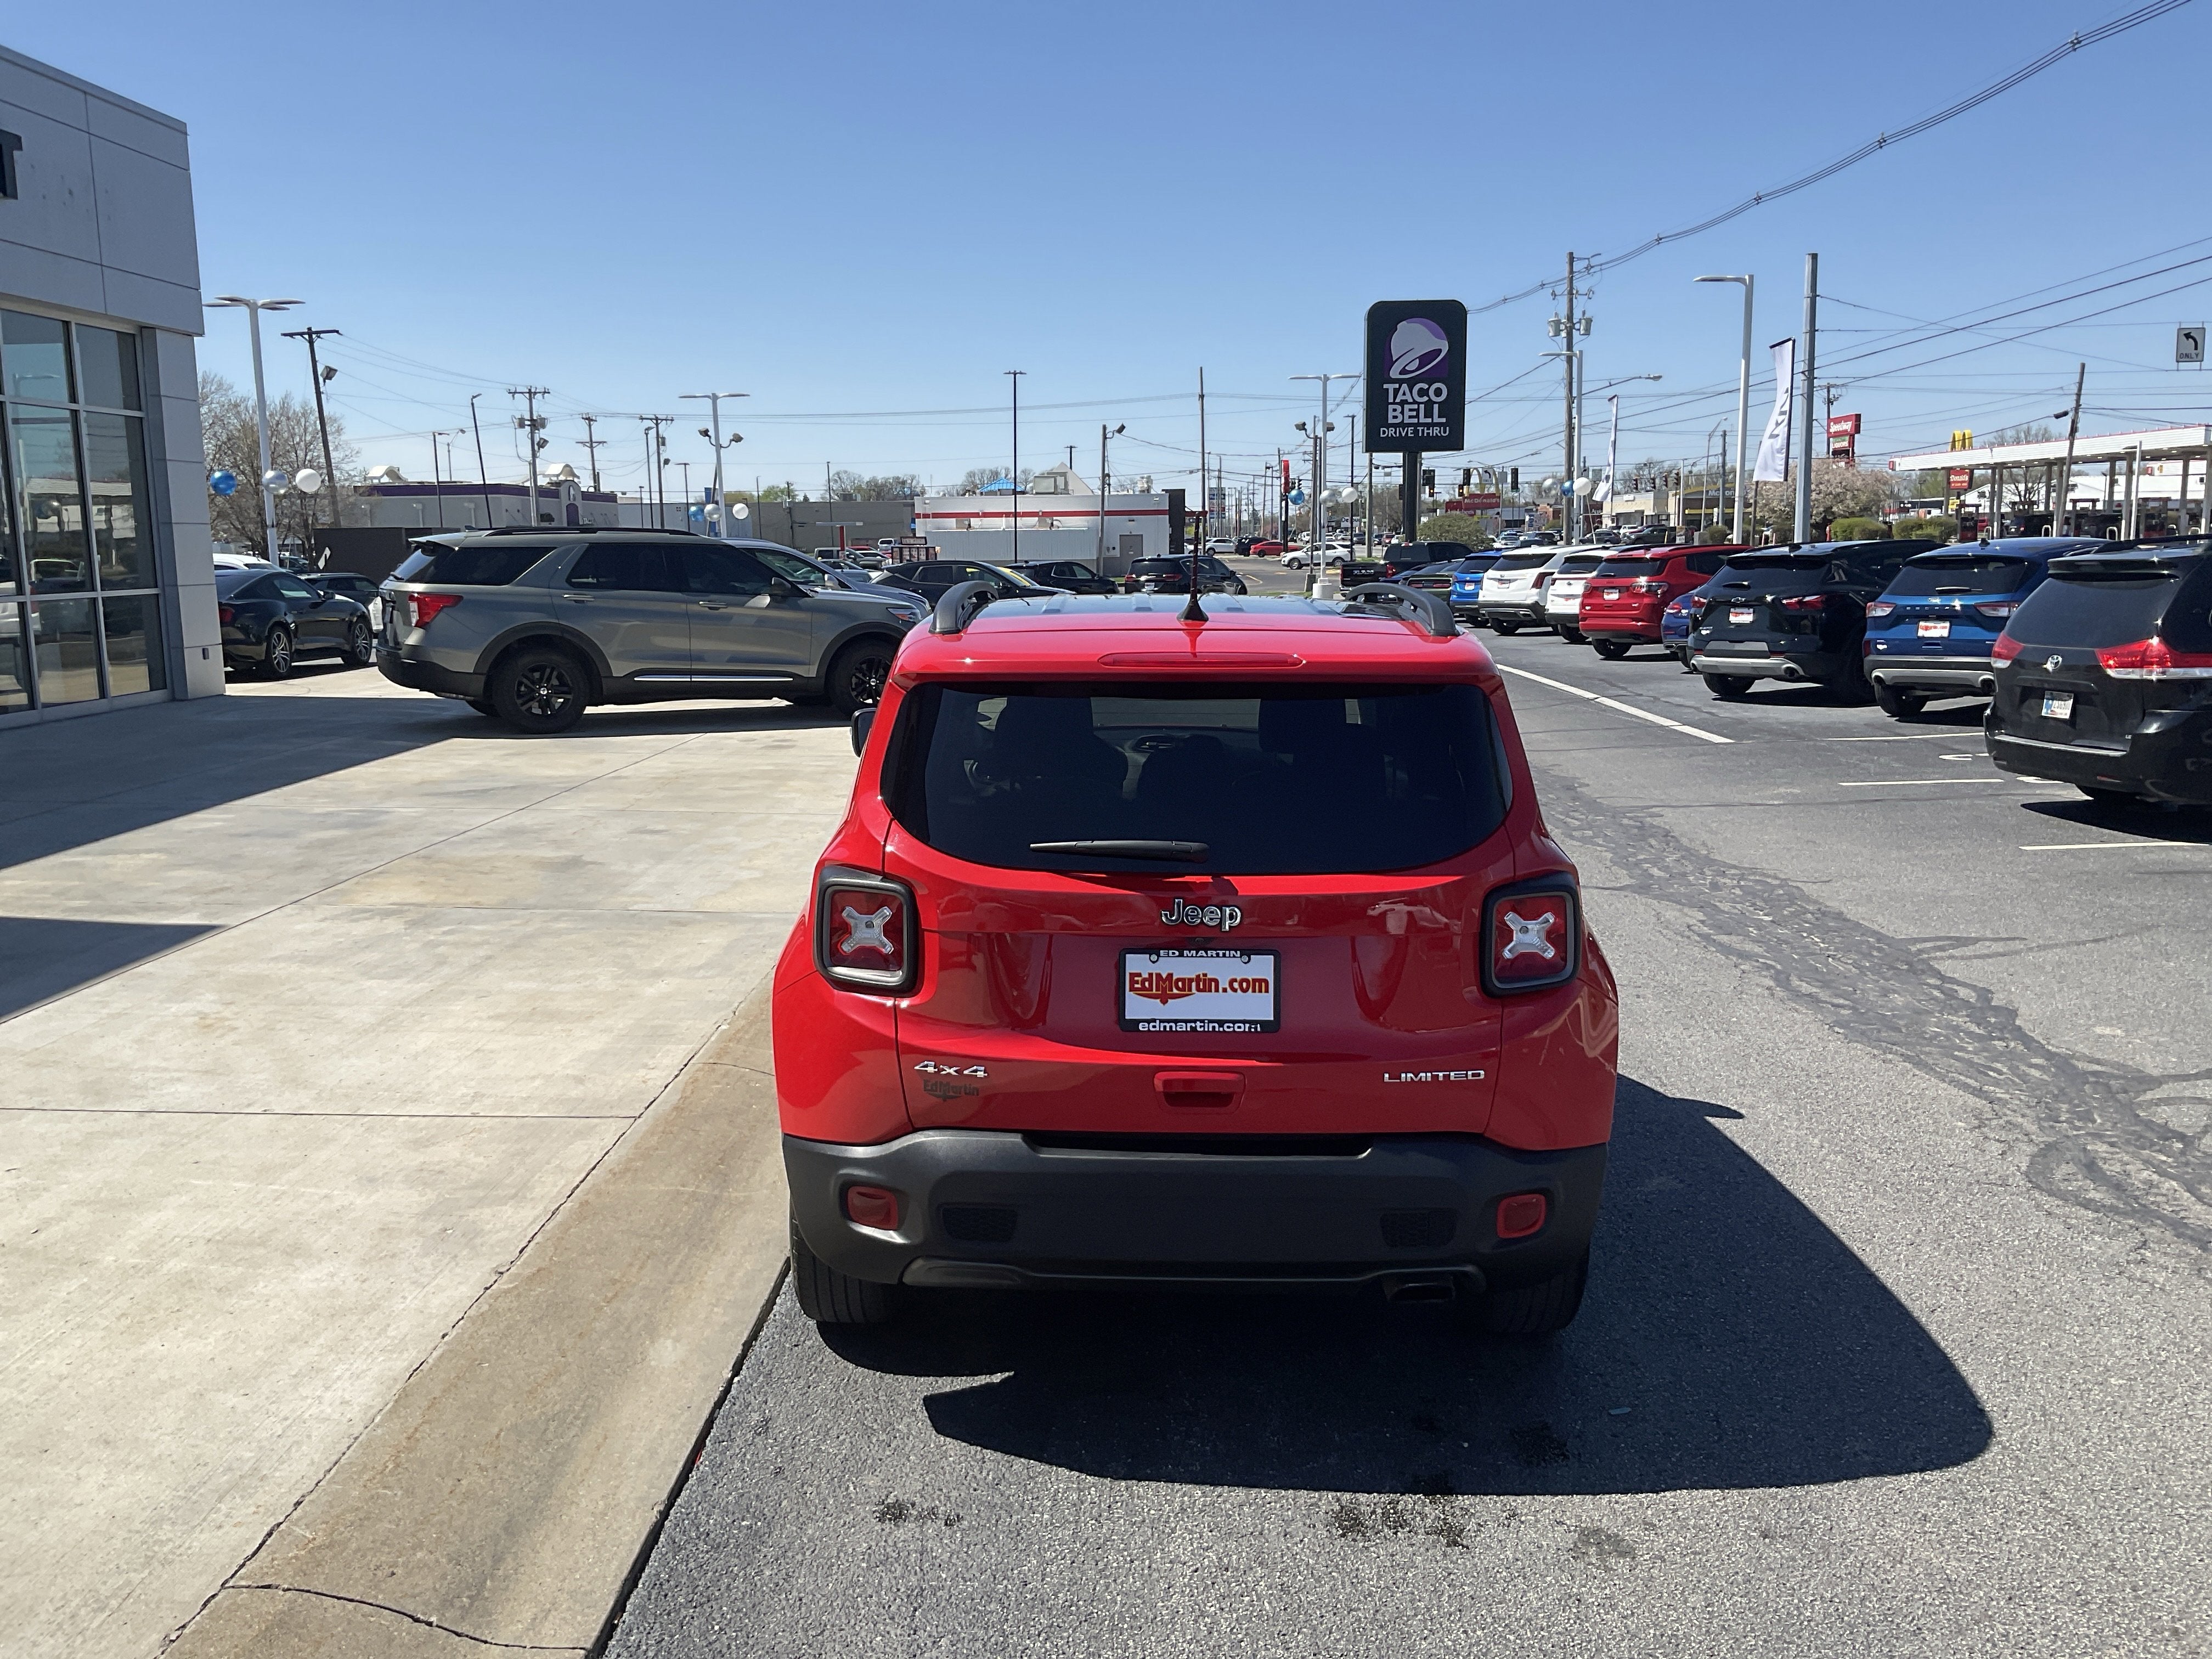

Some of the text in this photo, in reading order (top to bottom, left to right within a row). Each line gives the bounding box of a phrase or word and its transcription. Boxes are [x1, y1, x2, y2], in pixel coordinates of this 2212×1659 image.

[1383, 382, 1448, 403] TACO
[1387, 404, 1446, 424] BELL
[1380, 426, 1449, 437] DRIVE THRU
[1830, 420, 1853, 435] Speedway
[1161, 899, 1242, 932] Jeep
[1128, 972, 1269, 995] EdMartin.com
[913, 1060, 988, 1078] 4x4
[1384, 1070, 1485, 1082] LIMITED
[923, 1079, 980, 1097] EdMartin
